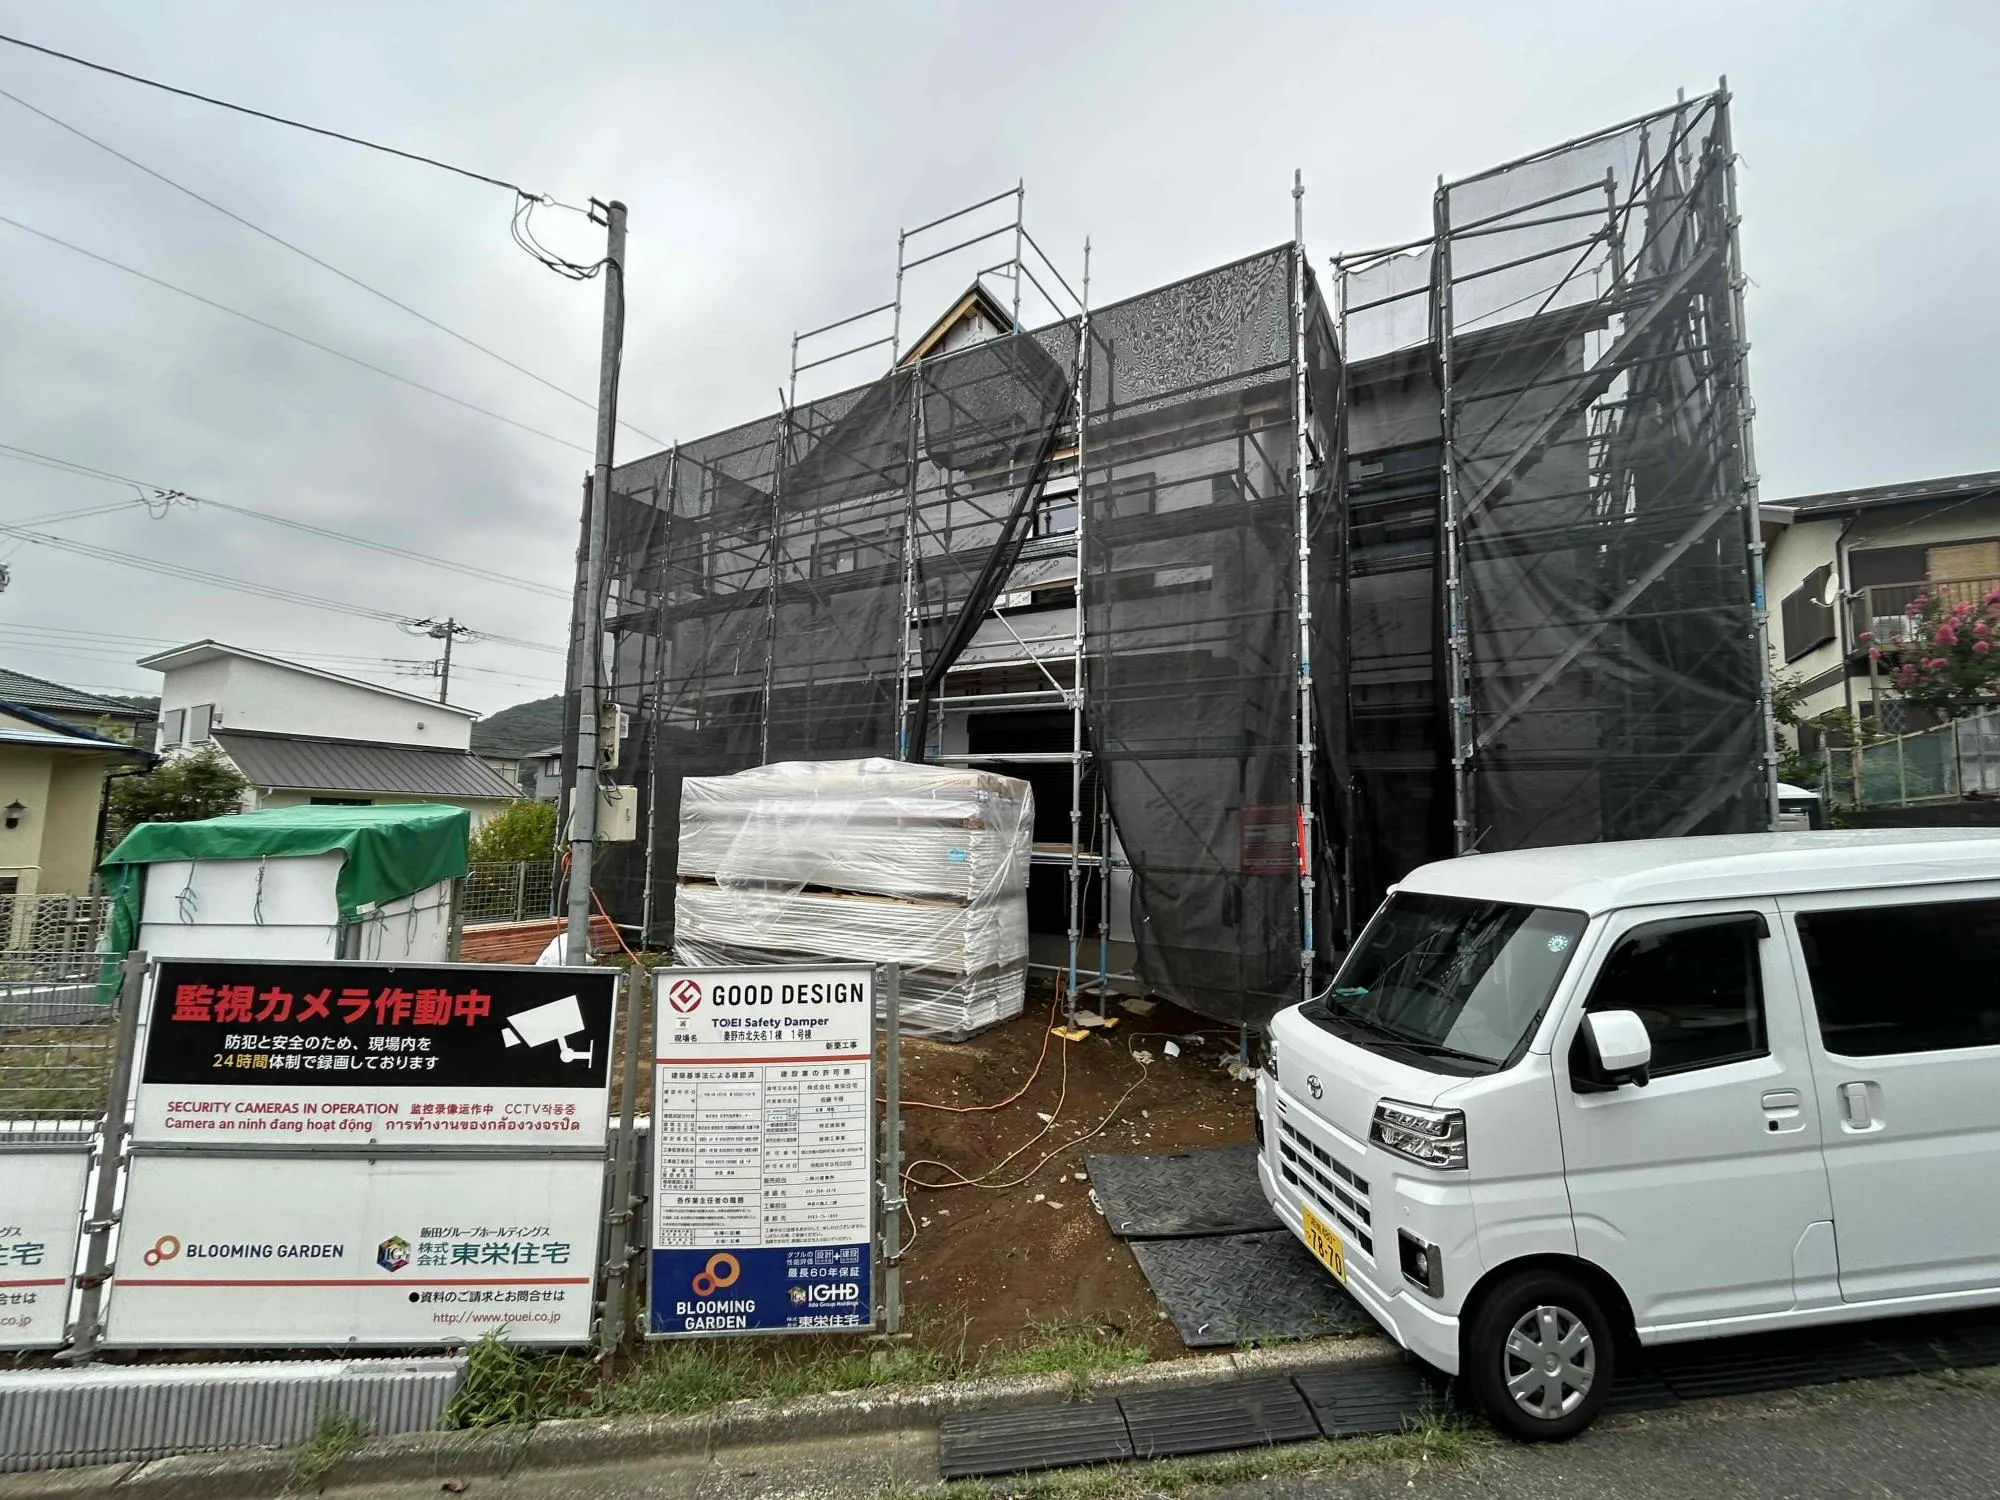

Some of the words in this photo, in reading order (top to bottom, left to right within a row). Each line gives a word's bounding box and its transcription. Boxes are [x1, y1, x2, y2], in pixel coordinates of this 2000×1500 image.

[712, 984, 773, 1006] GOOD
[782, 983, 864, 1005] DESIGN
[172, 984, 492, 1026] 監視カメラ作動中
[744, 1017, 781, 1029] Safety
[784, 1017, 829, 1028] Damper
[224, 1034, 432, 1052] 防犯と安全のため、現場内を
[212, 1054, 439, 1071] 24時間体制で録画しております
[167, 1101, 231, 1113] SECURITY
[235, 1102, 299, 1114] CAMERAS
[303, 1103, 317, 1114] IN
[321, 1103, 398, 1114] OPERATION
[410, 1103, 494, 1115] 监控录像运作中
[504, 1103, 576, 1115] CCTV작동중
[165, 1117, 216, 1129] Camera
[219, 1120, 235, 1129] an
[238, 1118, 266, 1130] ninh
[270, 1118, 303, 1132] đang
[306, 1118, 336, 1132] hoạt
[339, 1118, 372, 1133] động
[420, 1226, 550, 1239] 飯田グループホールディングス
[186, 1244, 273, 1258] BLOOMING
[277, 1244, 344, 1258] GARDEN
[417, 1241, 449, 1254] 株式
[450, 1242, 571, 1265] 東栄住宅
[1311, 1228, 1343, 1277] 78-70
[417, 1254, 448, 1266] 会社
[787, 1266, 860, 1278] 最長60年保証
[421, 1290, 566, 1304] 資料のご請求とお問合せは
[808, 1283, 859, 1302] IGHD
[676, 1300, 756, 1315] BLOOMING
[433, 1310, 561, 1325] http://www.touei.co.jp
[685, 1315, 747, 1330] GARDEN
[798, 1314, 860, 1328] 東栄住宅
